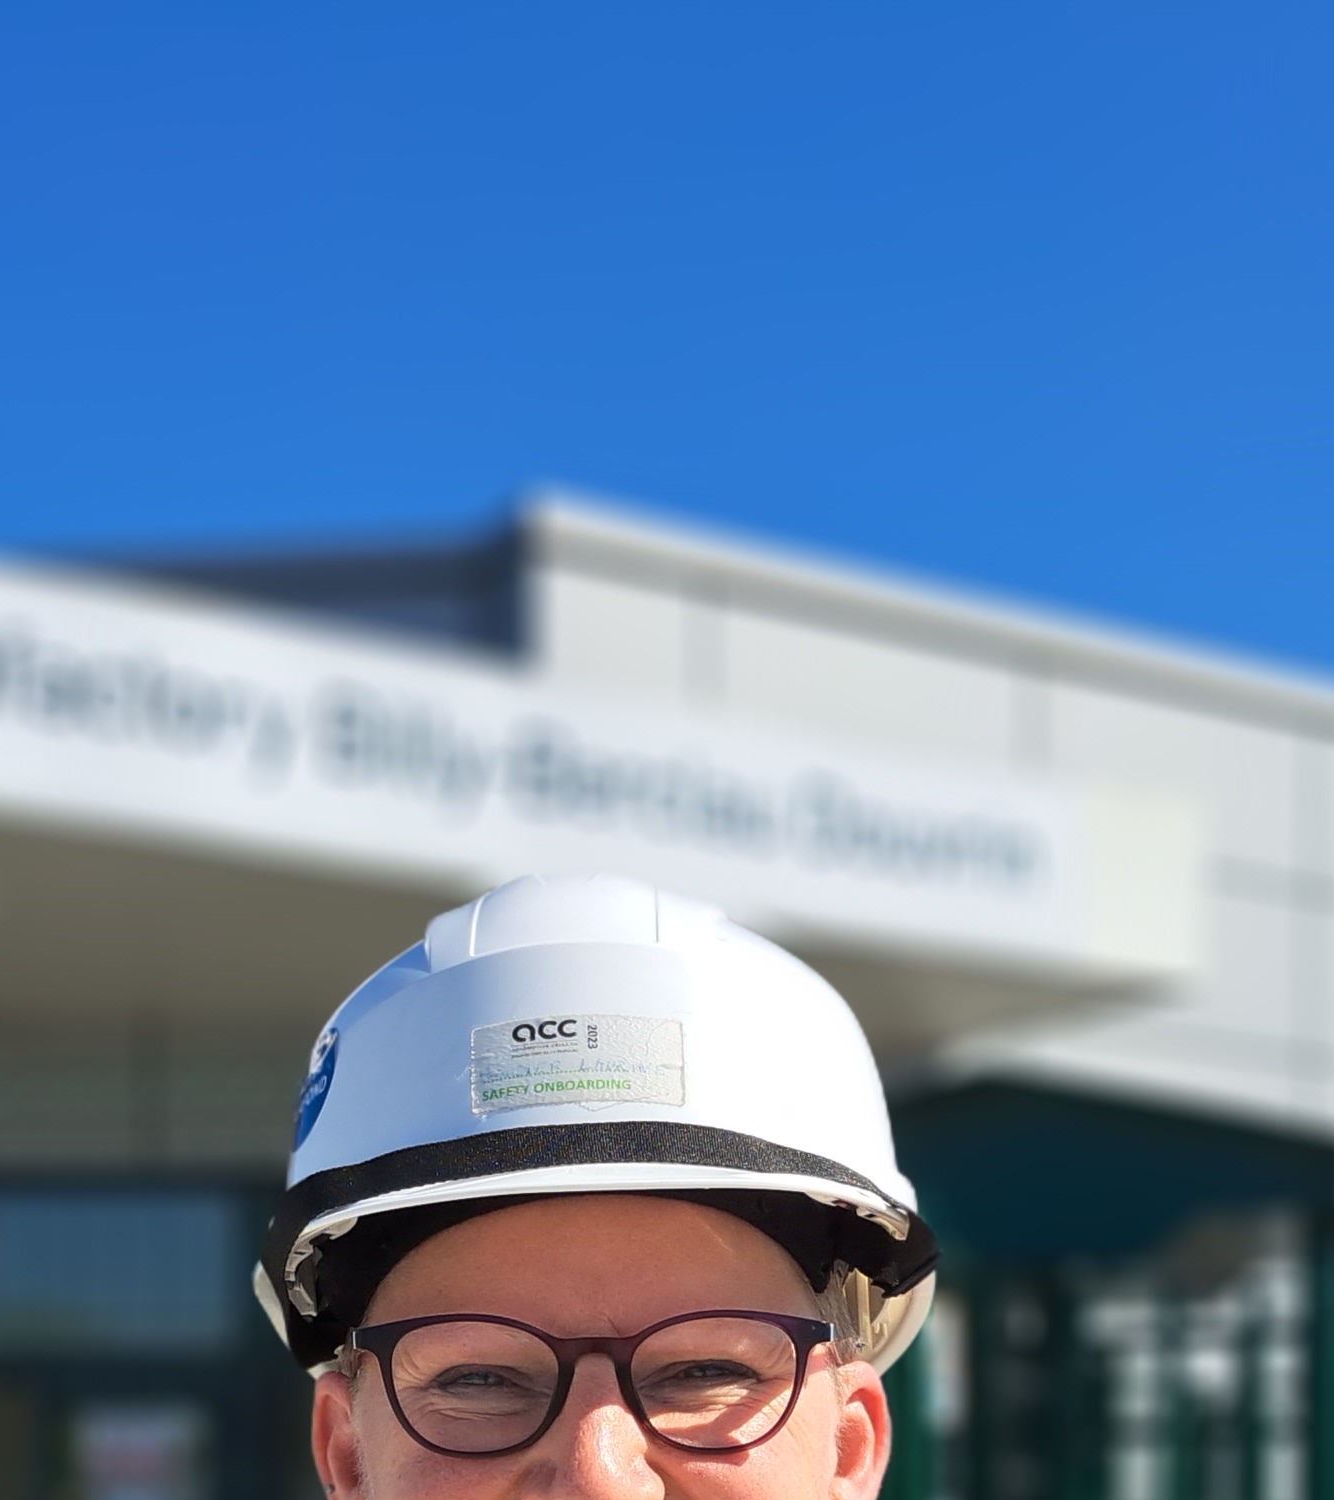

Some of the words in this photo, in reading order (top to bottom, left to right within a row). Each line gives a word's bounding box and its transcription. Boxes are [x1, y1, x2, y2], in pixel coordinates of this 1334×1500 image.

[512, 1019, 577, 1042] acc
[587, 1025, 598, 1050] 2023
[482, 1085, 530, 1101] SAFETY
[534, 1079, 632, 1093] ONBOARDING
